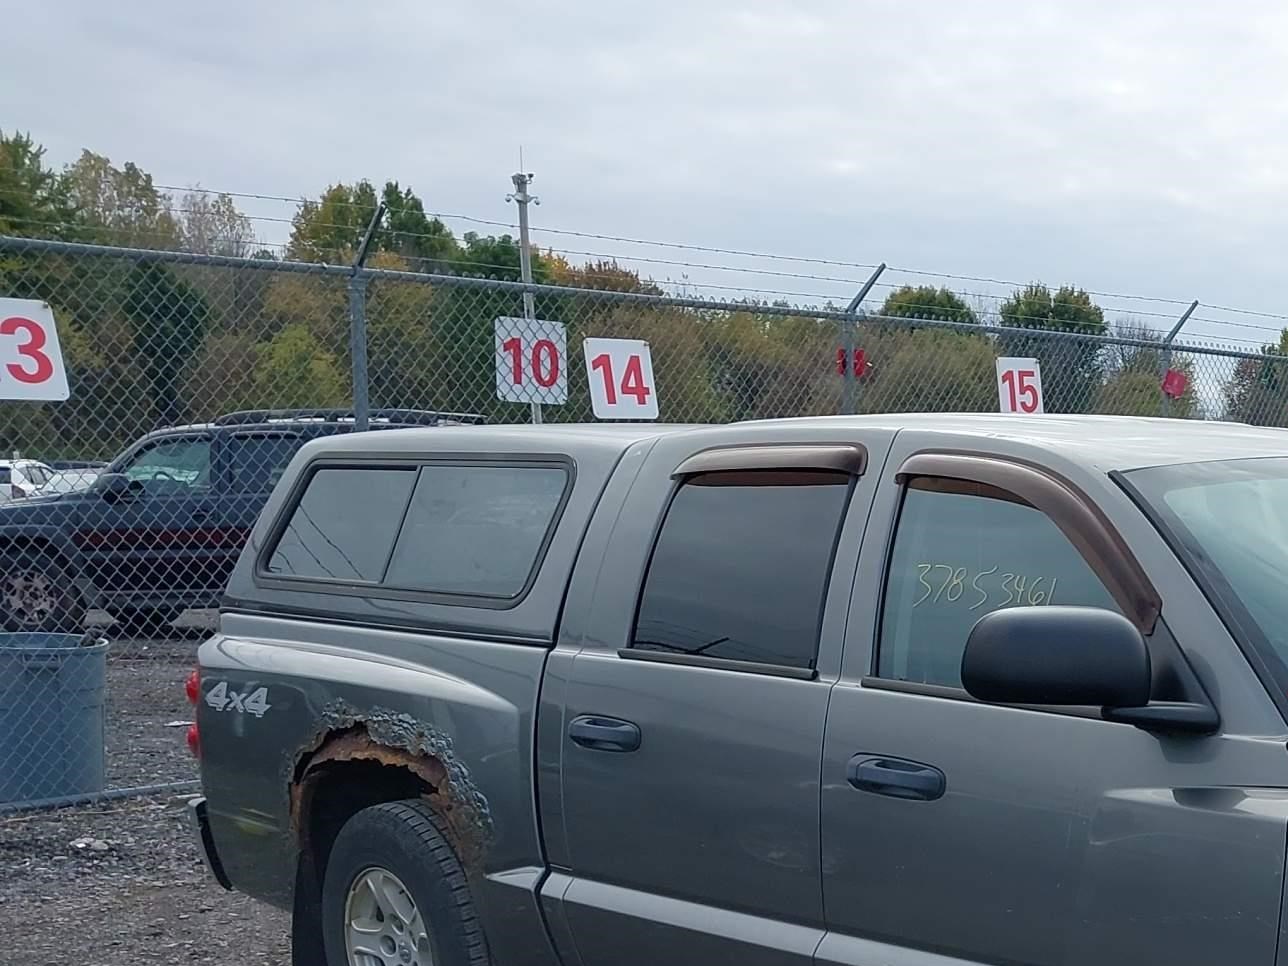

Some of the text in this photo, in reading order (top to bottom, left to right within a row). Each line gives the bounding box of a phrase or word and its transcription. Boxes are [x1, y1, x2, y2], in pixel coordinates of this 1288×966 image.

[0, 317, 54, 384] 3
[503, 337, 559, 388] 10
[591, 353, 651, 405] 14
[1001, 370, 1039, 413] 15
[912, 564, 1058, 610] 37853461
[205, 681, 273, 718] 4x4
